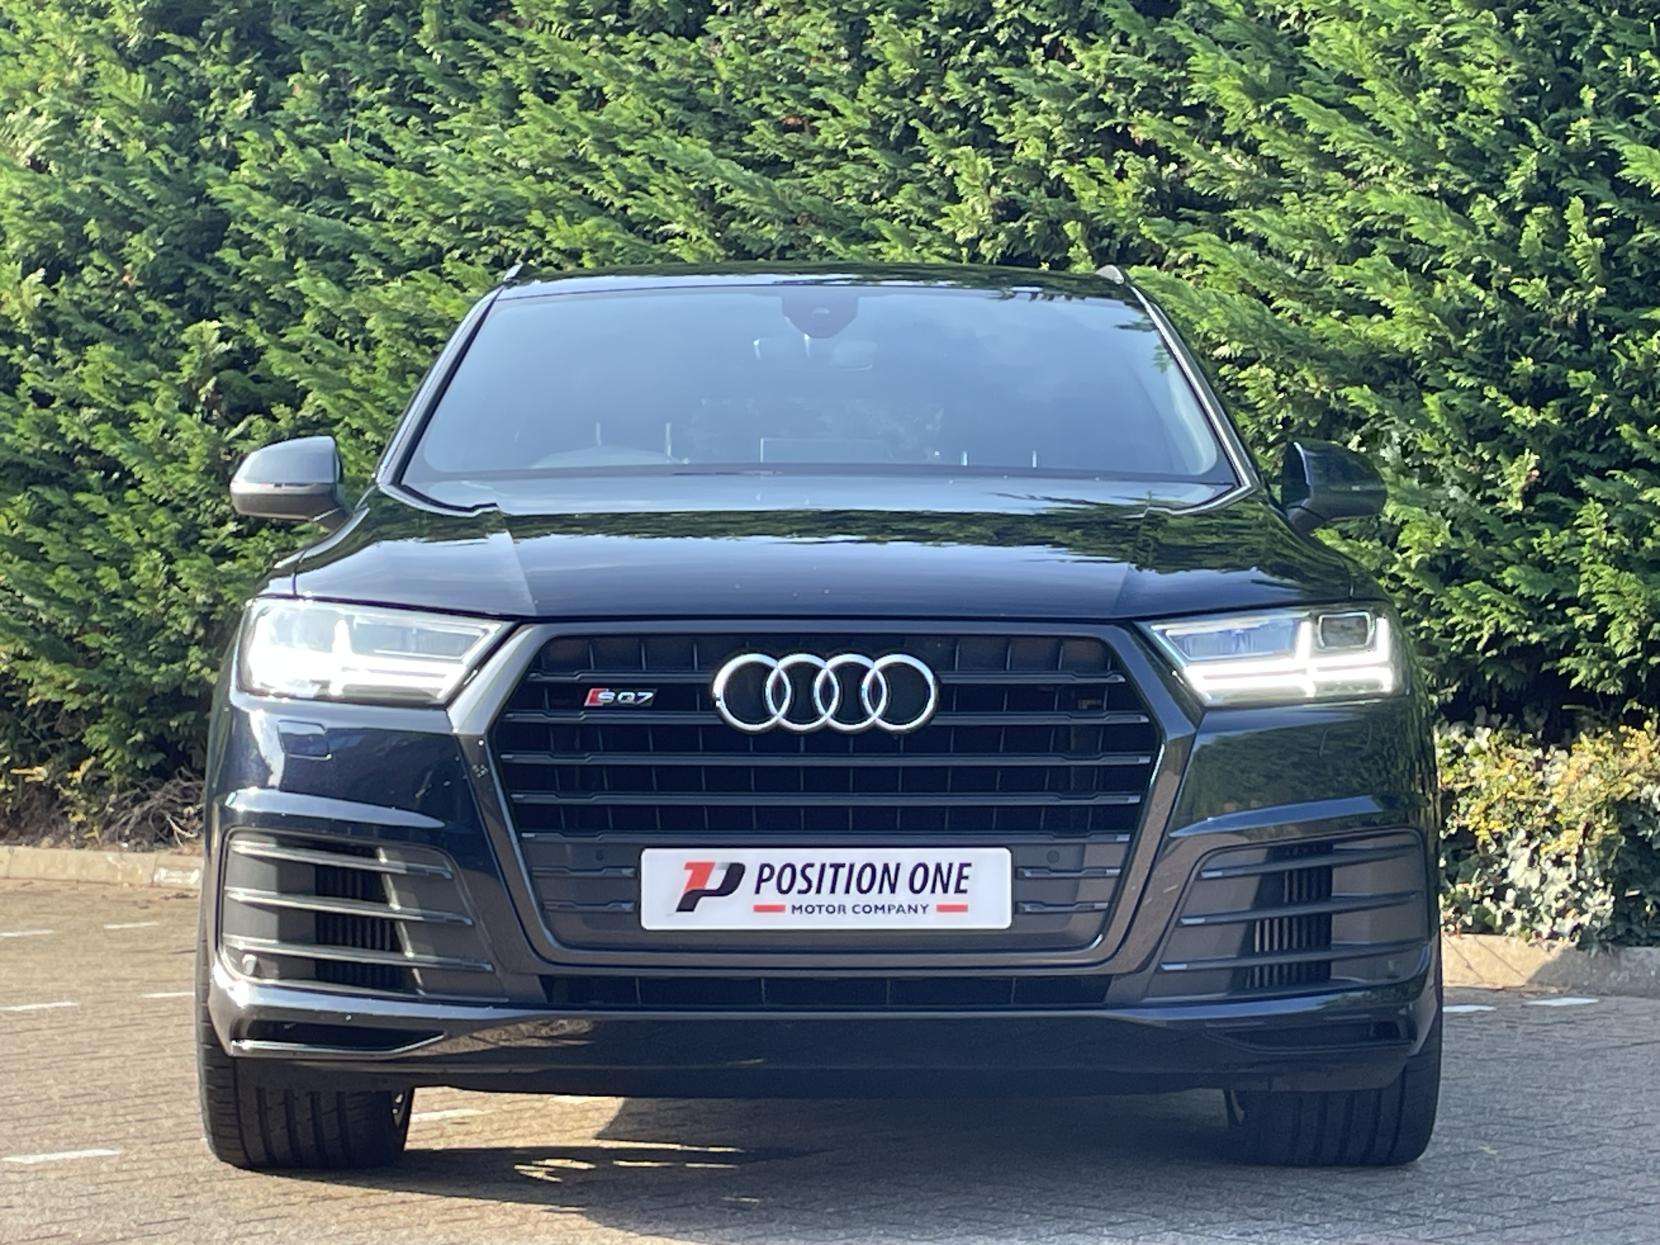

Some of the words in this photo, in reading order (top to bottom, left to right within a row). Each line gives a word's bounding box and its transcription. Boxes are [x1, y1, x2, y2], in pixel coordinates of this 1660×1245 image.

[754, 861, 905, 895] POSITION
[908, 861, 972, 895] ONE
[791, 903, 847, 915] MOTOR
[852, 903, 930, 915] COMPANY
